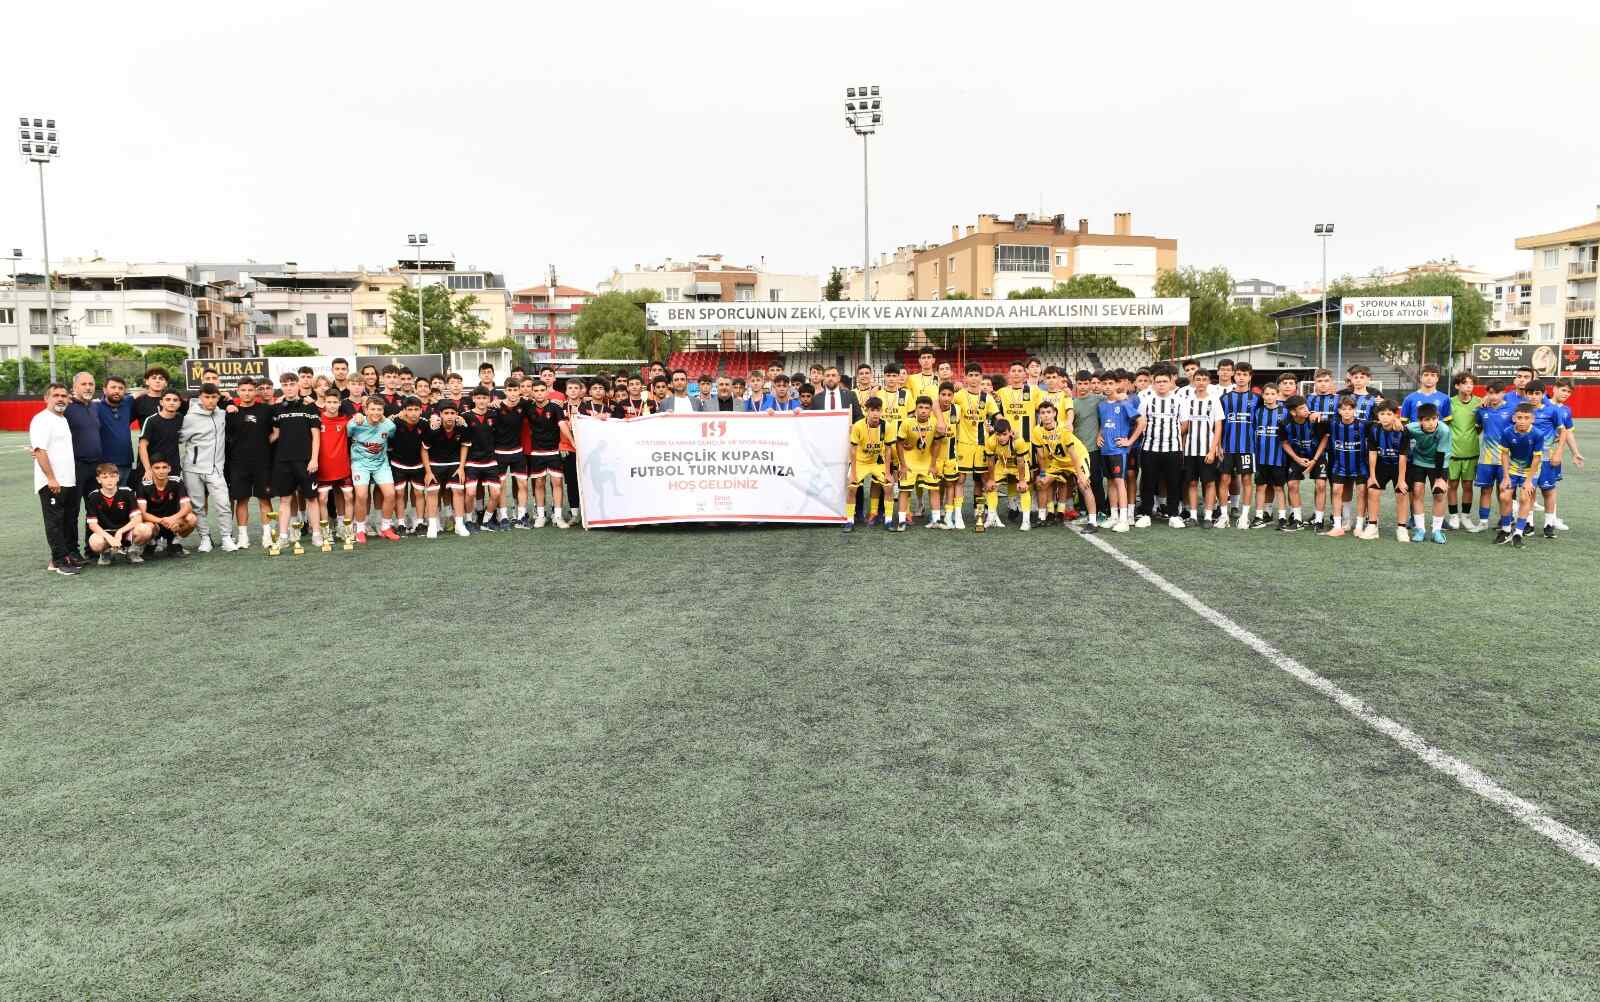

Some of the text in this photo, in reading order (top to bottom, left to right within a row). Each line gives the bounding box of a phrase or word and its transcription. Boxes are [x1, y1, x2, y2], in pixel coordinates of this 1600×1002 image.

[1360, 300, 1398, 308] SPORUN
[668, 308, 695, 320] BEN
[700, 307, 787, 320] SPORCUNUN
[791, 306, 825, 321] ZEKİ,
[829, 306, 870, 322] ÇEVİK
[874, 306, 891, 319] VE
[895, 306, 927, 319] AYNI
[931, 305, 1005, 318] ZAMANDA
[1009, 304, 1098, 318] AHLAKLISINI
[1397, 309, 1429, 317] ATIYOR
[208, 361, 264, 375] MURAT
[651, 449, 774, 464] GENÇLİK KUPASI
[1240, 455, 1251, 465] 16
[630, 465, 795, 478] FUTBOL TURNUVAMIZA
[1319, 464, 1327, 474] 2
[668, 477, 759, 492] HOŞ GELDİNİZ
